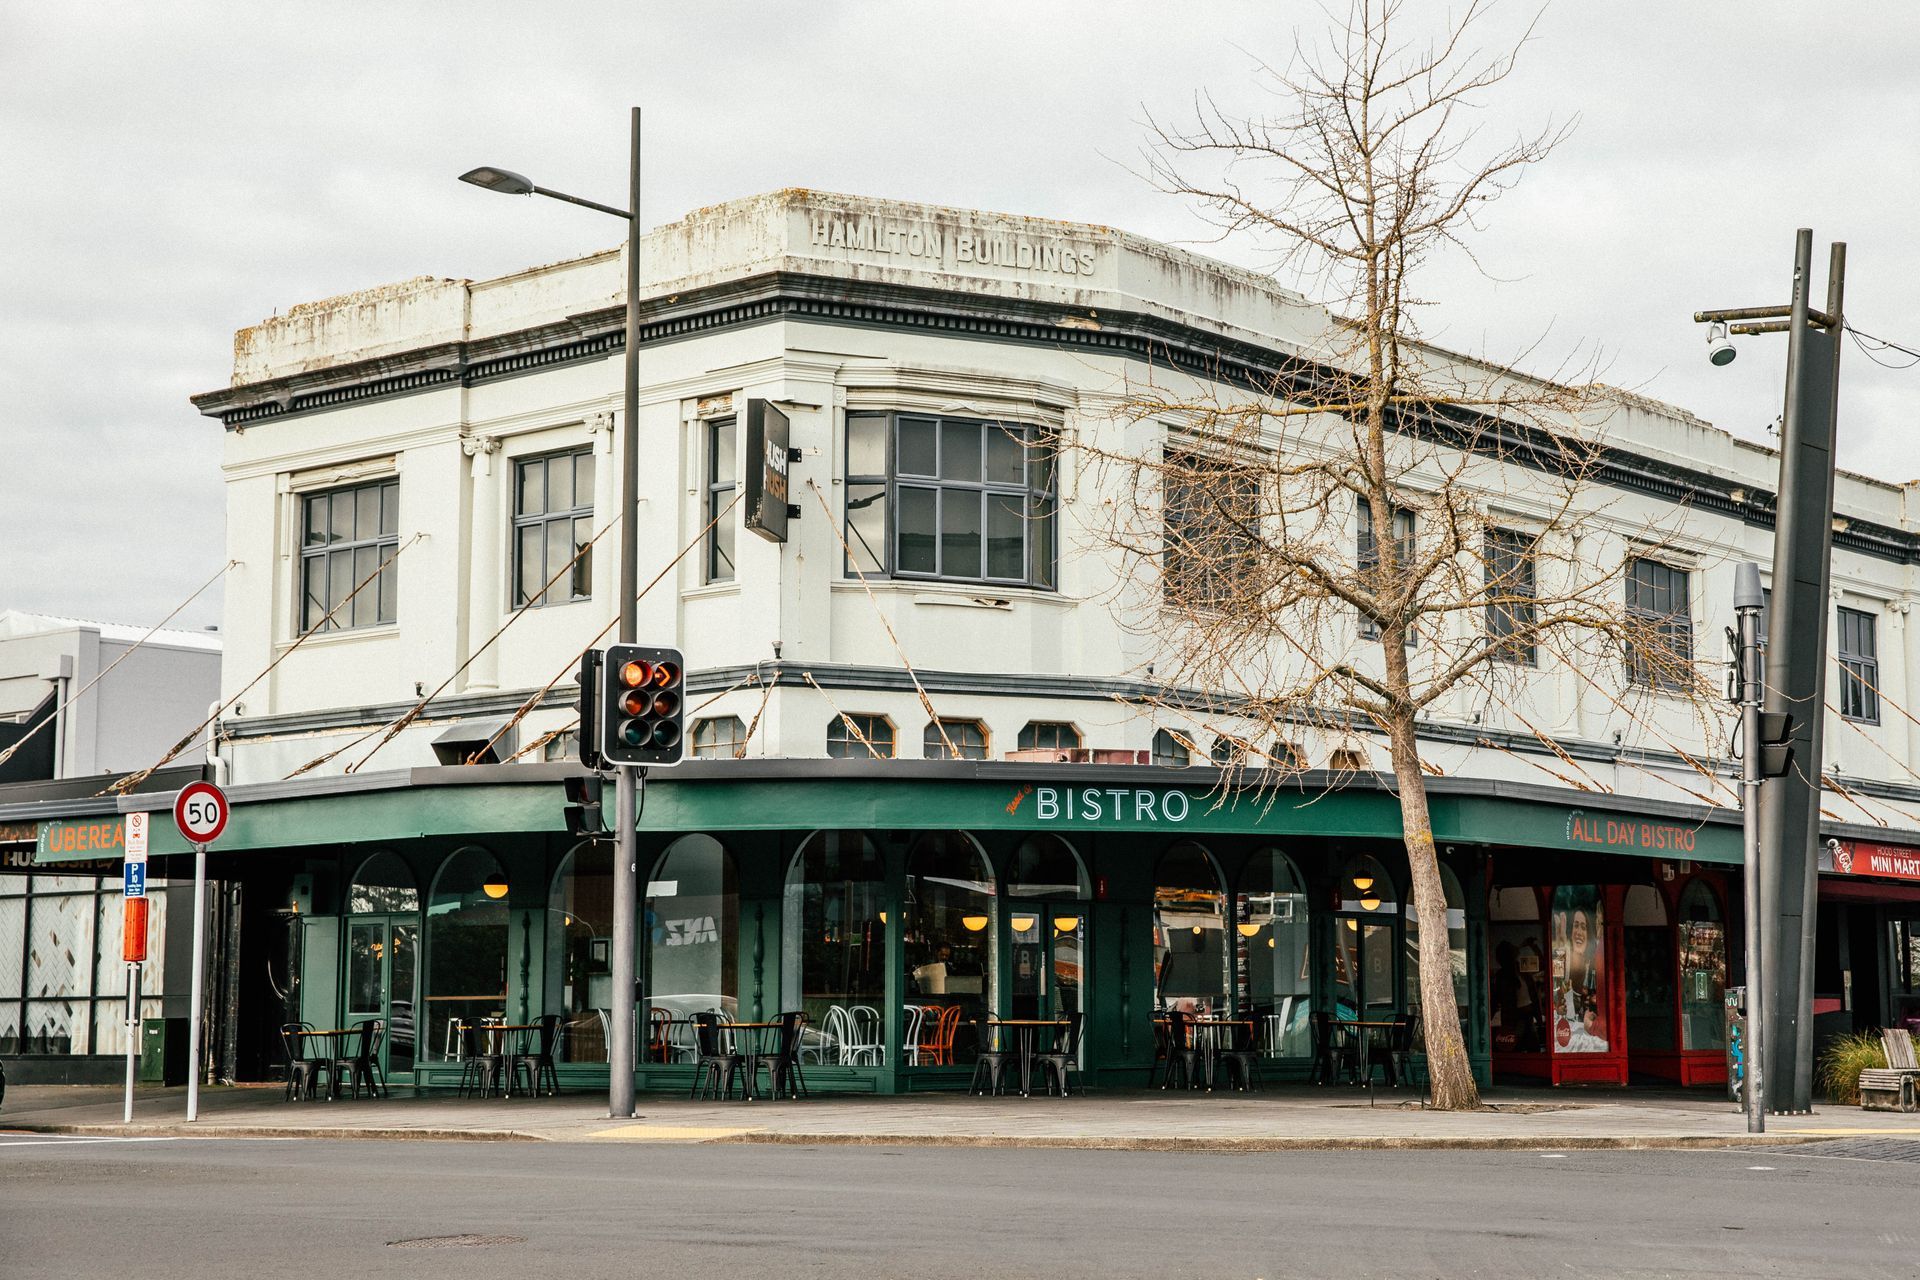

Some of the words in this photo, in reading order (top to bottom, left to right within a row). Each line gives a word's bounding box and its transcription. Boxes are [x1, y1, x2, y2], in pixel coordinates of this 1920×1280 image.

[812, 217, 942, 259] HAMILTON
[957, 236, 1096, 276] BUILDINGS
[188, 802, 218, 825] 50
[1037, 788, 1189, 822] BISTRO
[50, 823, 126, 852] UBEREA
[1573, 818, 1603, 843] ALL
[1607, 821, 1636, 846] DAY
[1641, 824, 1695, 852] BISTRO
[1877, 847, 1892, 856] HOOD
[1894, 849, 1912, 858] STREET
[132, 864, 138, 874] P
[631, 863, 636, 873] 6
[1871, 856, 1892, 873] MINI
[1894, 858, 1920, 876] MART
